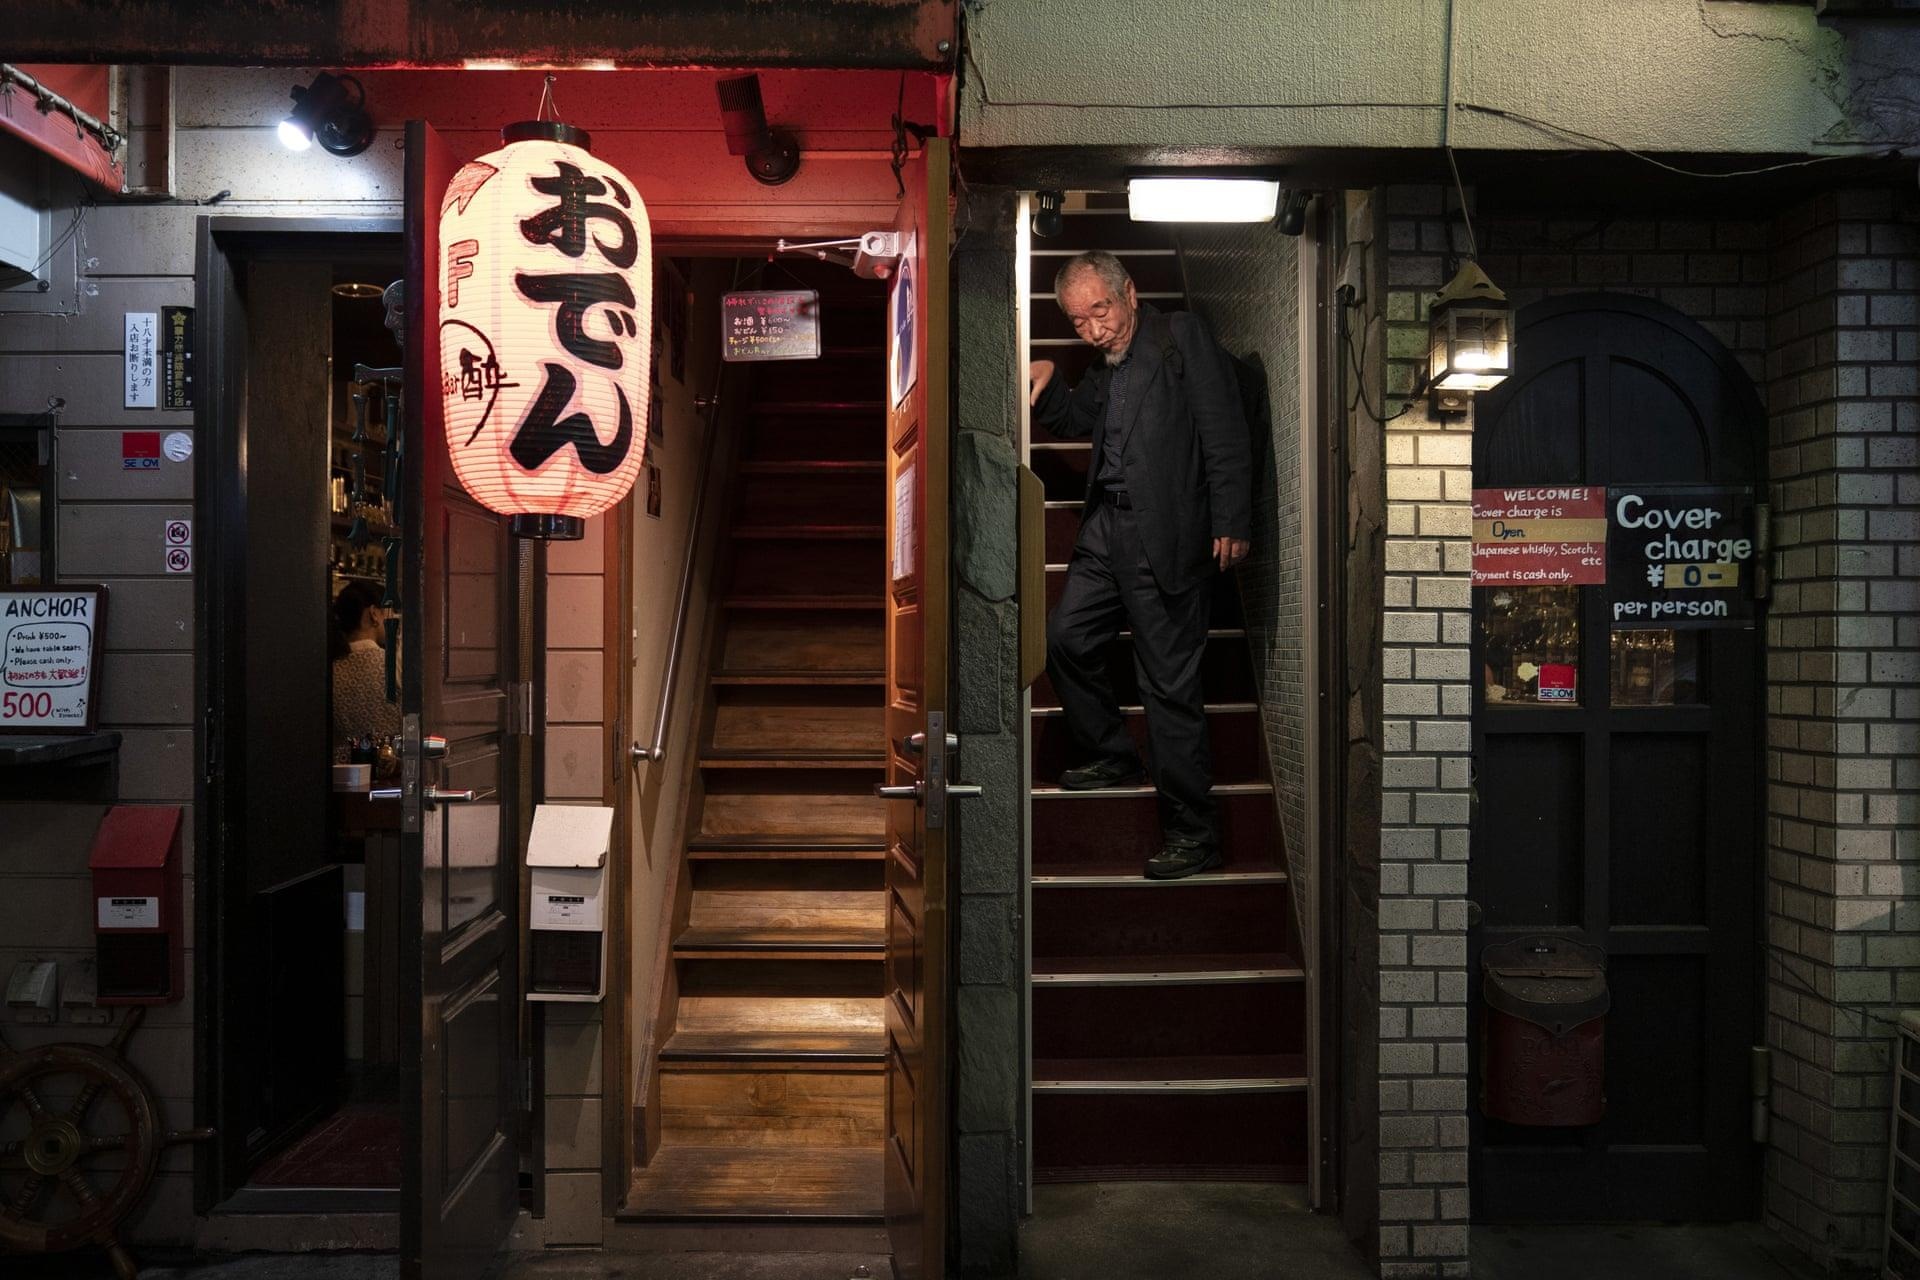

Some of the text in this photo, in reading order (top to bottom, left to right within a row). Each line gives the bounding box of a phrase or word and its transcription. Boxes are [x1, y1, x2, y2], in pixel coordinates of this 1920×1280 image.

[510, 159, 638, 475] おでん
[142, 317, 152, 387] 十八才未満の方
[129, 323, 140, 402] 入店お断りします
[1503, 488, 1589, 502] WELCOME!
[1472, 504, 1563, 520] Cover charge is
[1616, 494, 1722, 530] Cover
[1472, 542, 1597, 558] Japanese whisky, Scotch,
[1644, 533, 1752, 564] charge
[1581, 557, 1603, 566] etc
[1471, 568, 1573, 583] Payment is cash only.
[5, 597, 87, 617] ANCHOR
[1613, 599, 1728, 621] per person
[14, 657, 38, 666] Please
[39, 656, 54, 664] cash
[1540, 688, 1574, 698] SECOM
[3, 691, 52, 718] 500
